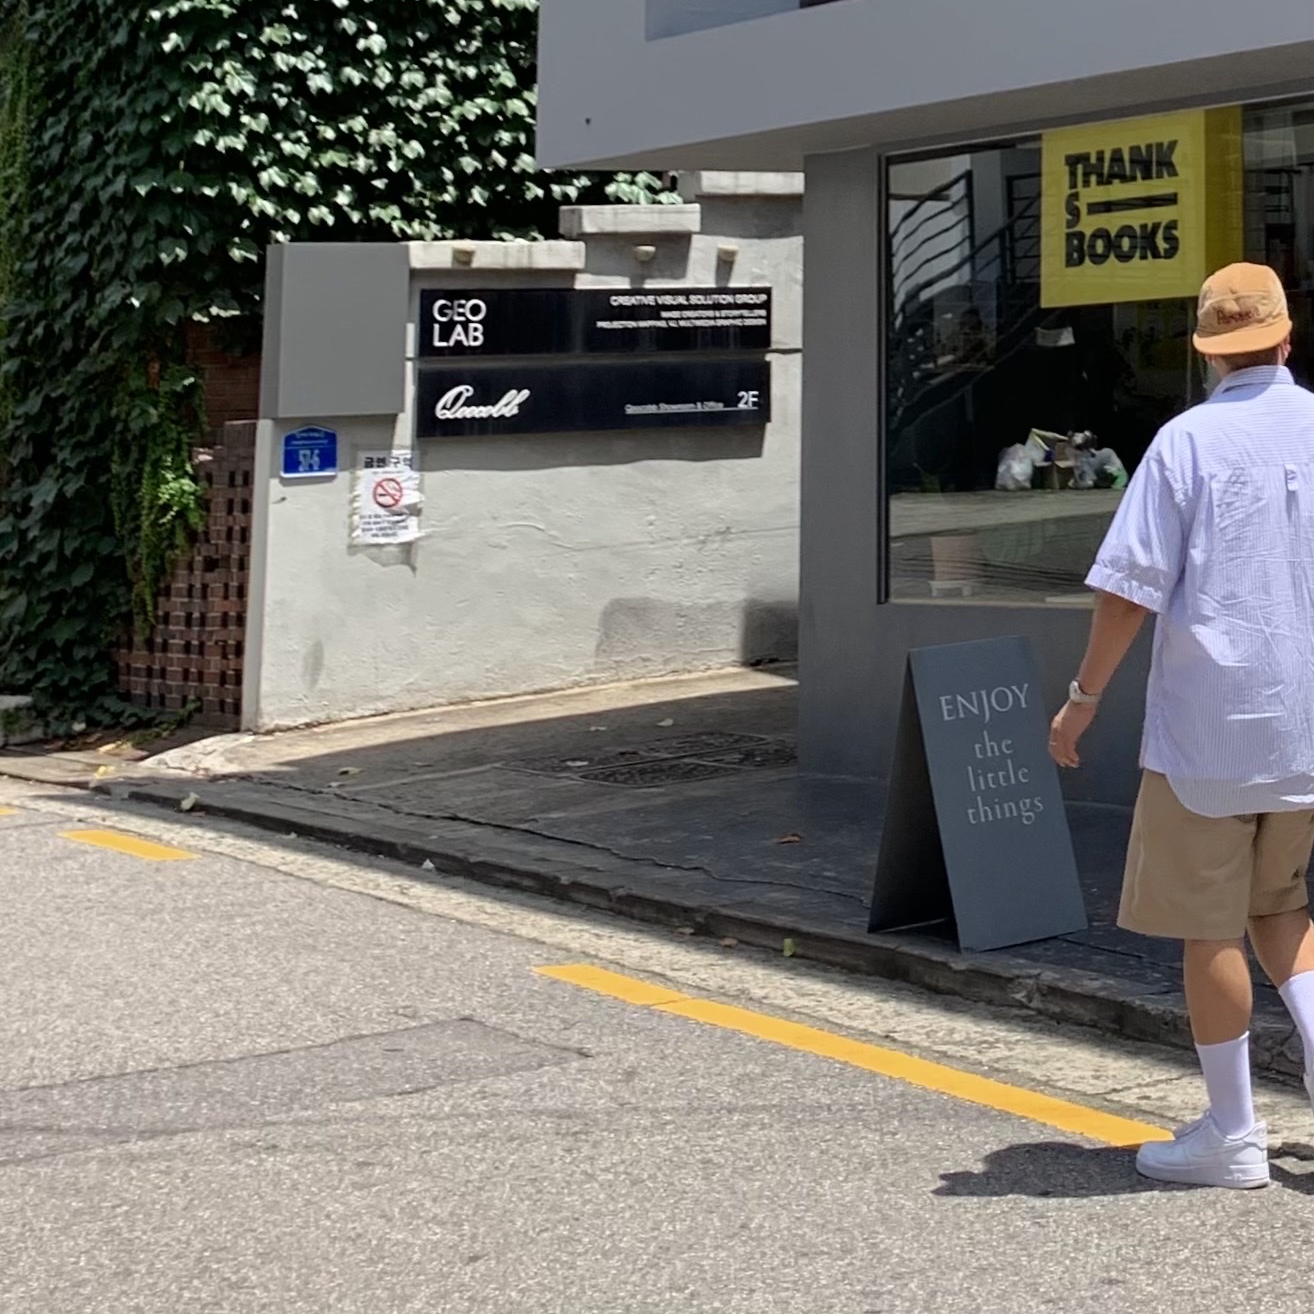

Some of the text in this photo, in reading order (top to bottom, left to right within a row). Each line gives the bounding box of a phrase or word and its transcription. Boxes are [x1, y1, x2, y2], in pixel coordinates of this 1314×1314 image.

[1064, 139, 1179, 190] THANK
[1064, 219, 1180, 268] BOOKS
[432, 299, 487, 322] GEO
[433, 323, 485, 347] LAB
[737, 390, 760, 408] 2F
[938, 683, 1029, 724] ENJOY
[974, 730, 1014, 759] the
[967, 758, 1029, 792] little
[967, 796, 1044, 825] things
